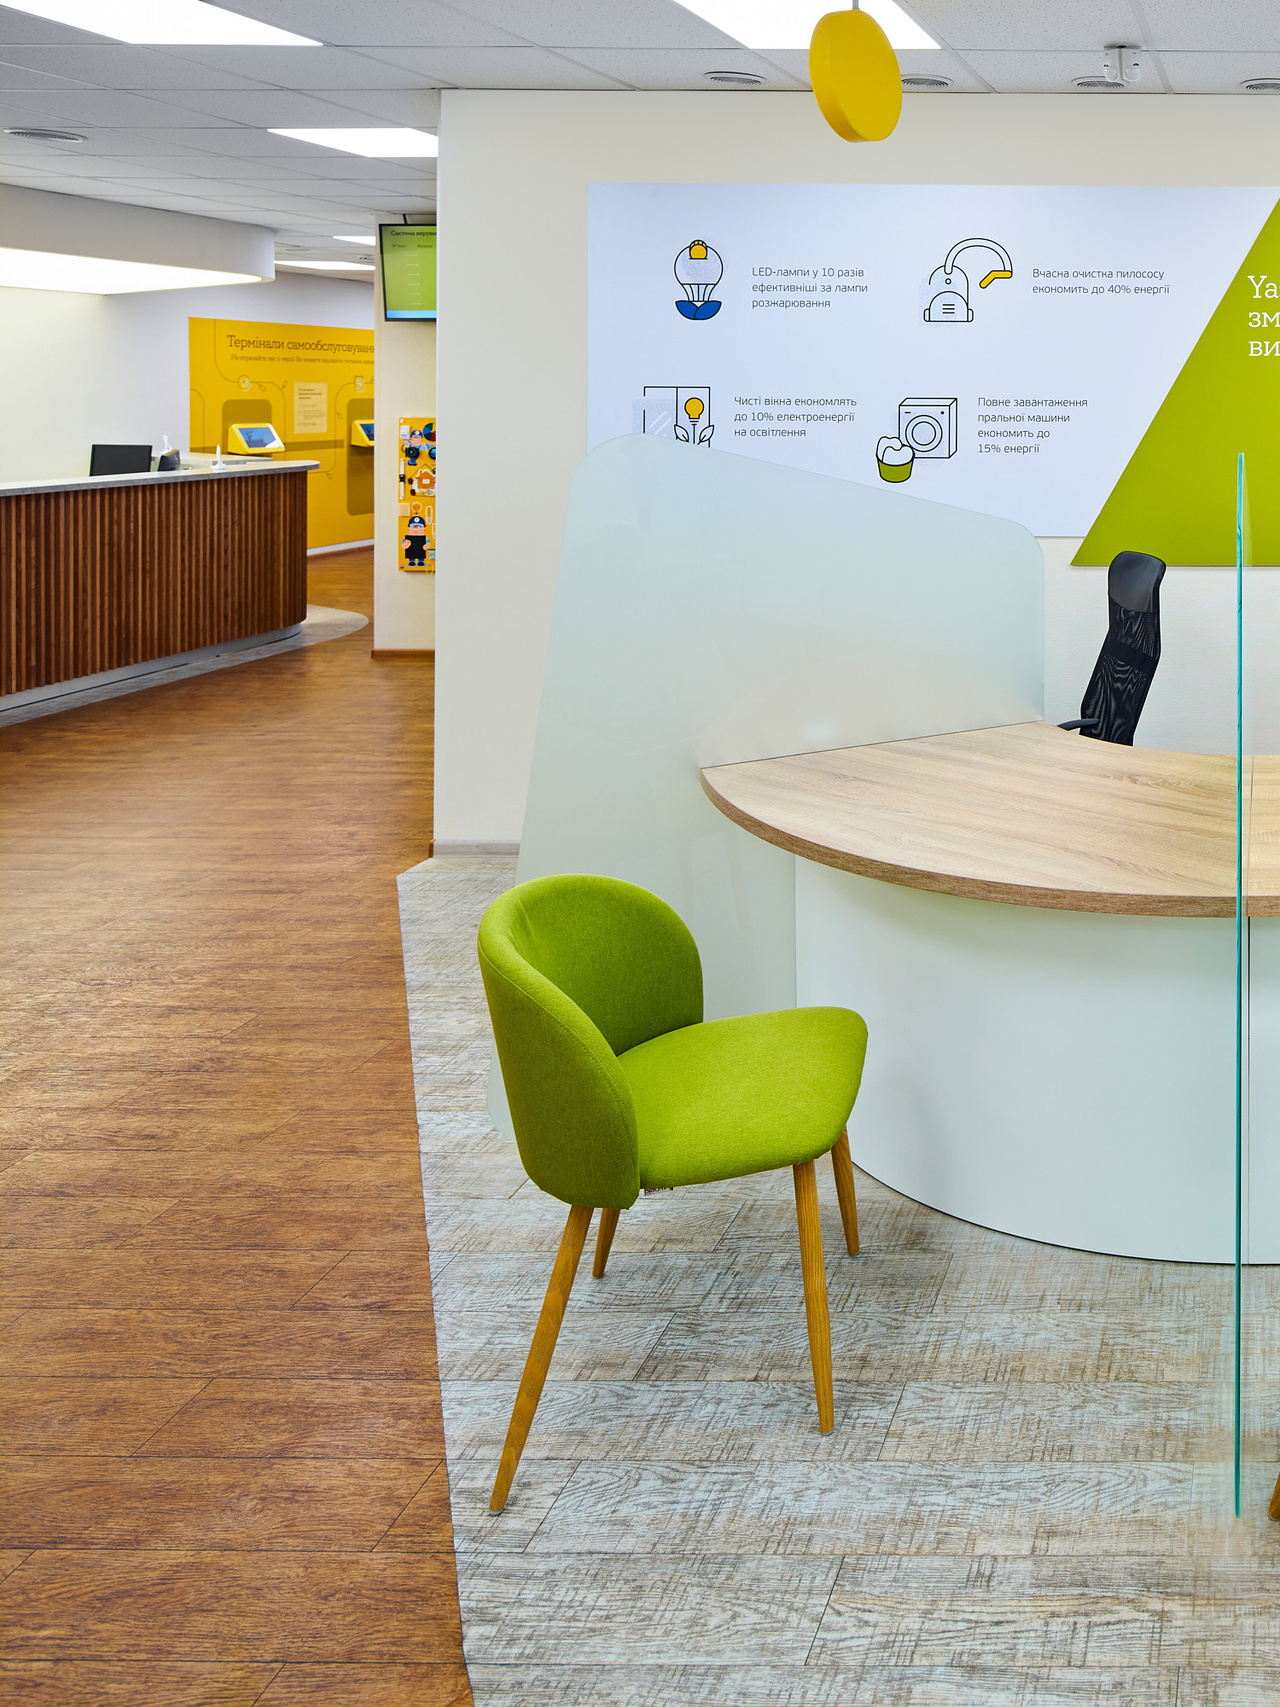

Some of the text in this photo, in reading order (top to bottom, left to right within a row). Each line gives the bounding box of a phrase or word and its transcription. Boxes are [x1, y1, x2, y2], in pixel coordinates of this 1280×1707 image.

[752, 266, 864, 279] LED-лампи у 10 разів
[1032, 268, 1164, 280] Вчасна очистка пилососу
[752, 282, 868, 294] ефективніші за лампи
[1032, 284, 1170, 296] економить до 40% енергії
[752, 299, 831, 310] розжарювання
[226, 334, 284, 350] Термінали
[734, 396, 858, 406] Чисті вікна економлять
[978, 397, 1088, 407] Повне завантаження
[734, 412, 856, 424] до 10% електроенергії
[978, 412, 1070, 424] пральної машини
[734, 427, 806, 437] на освітлення
[978, 430, 1050, 439] економить до
[978, 444, 1040, 455] 15% енергії
